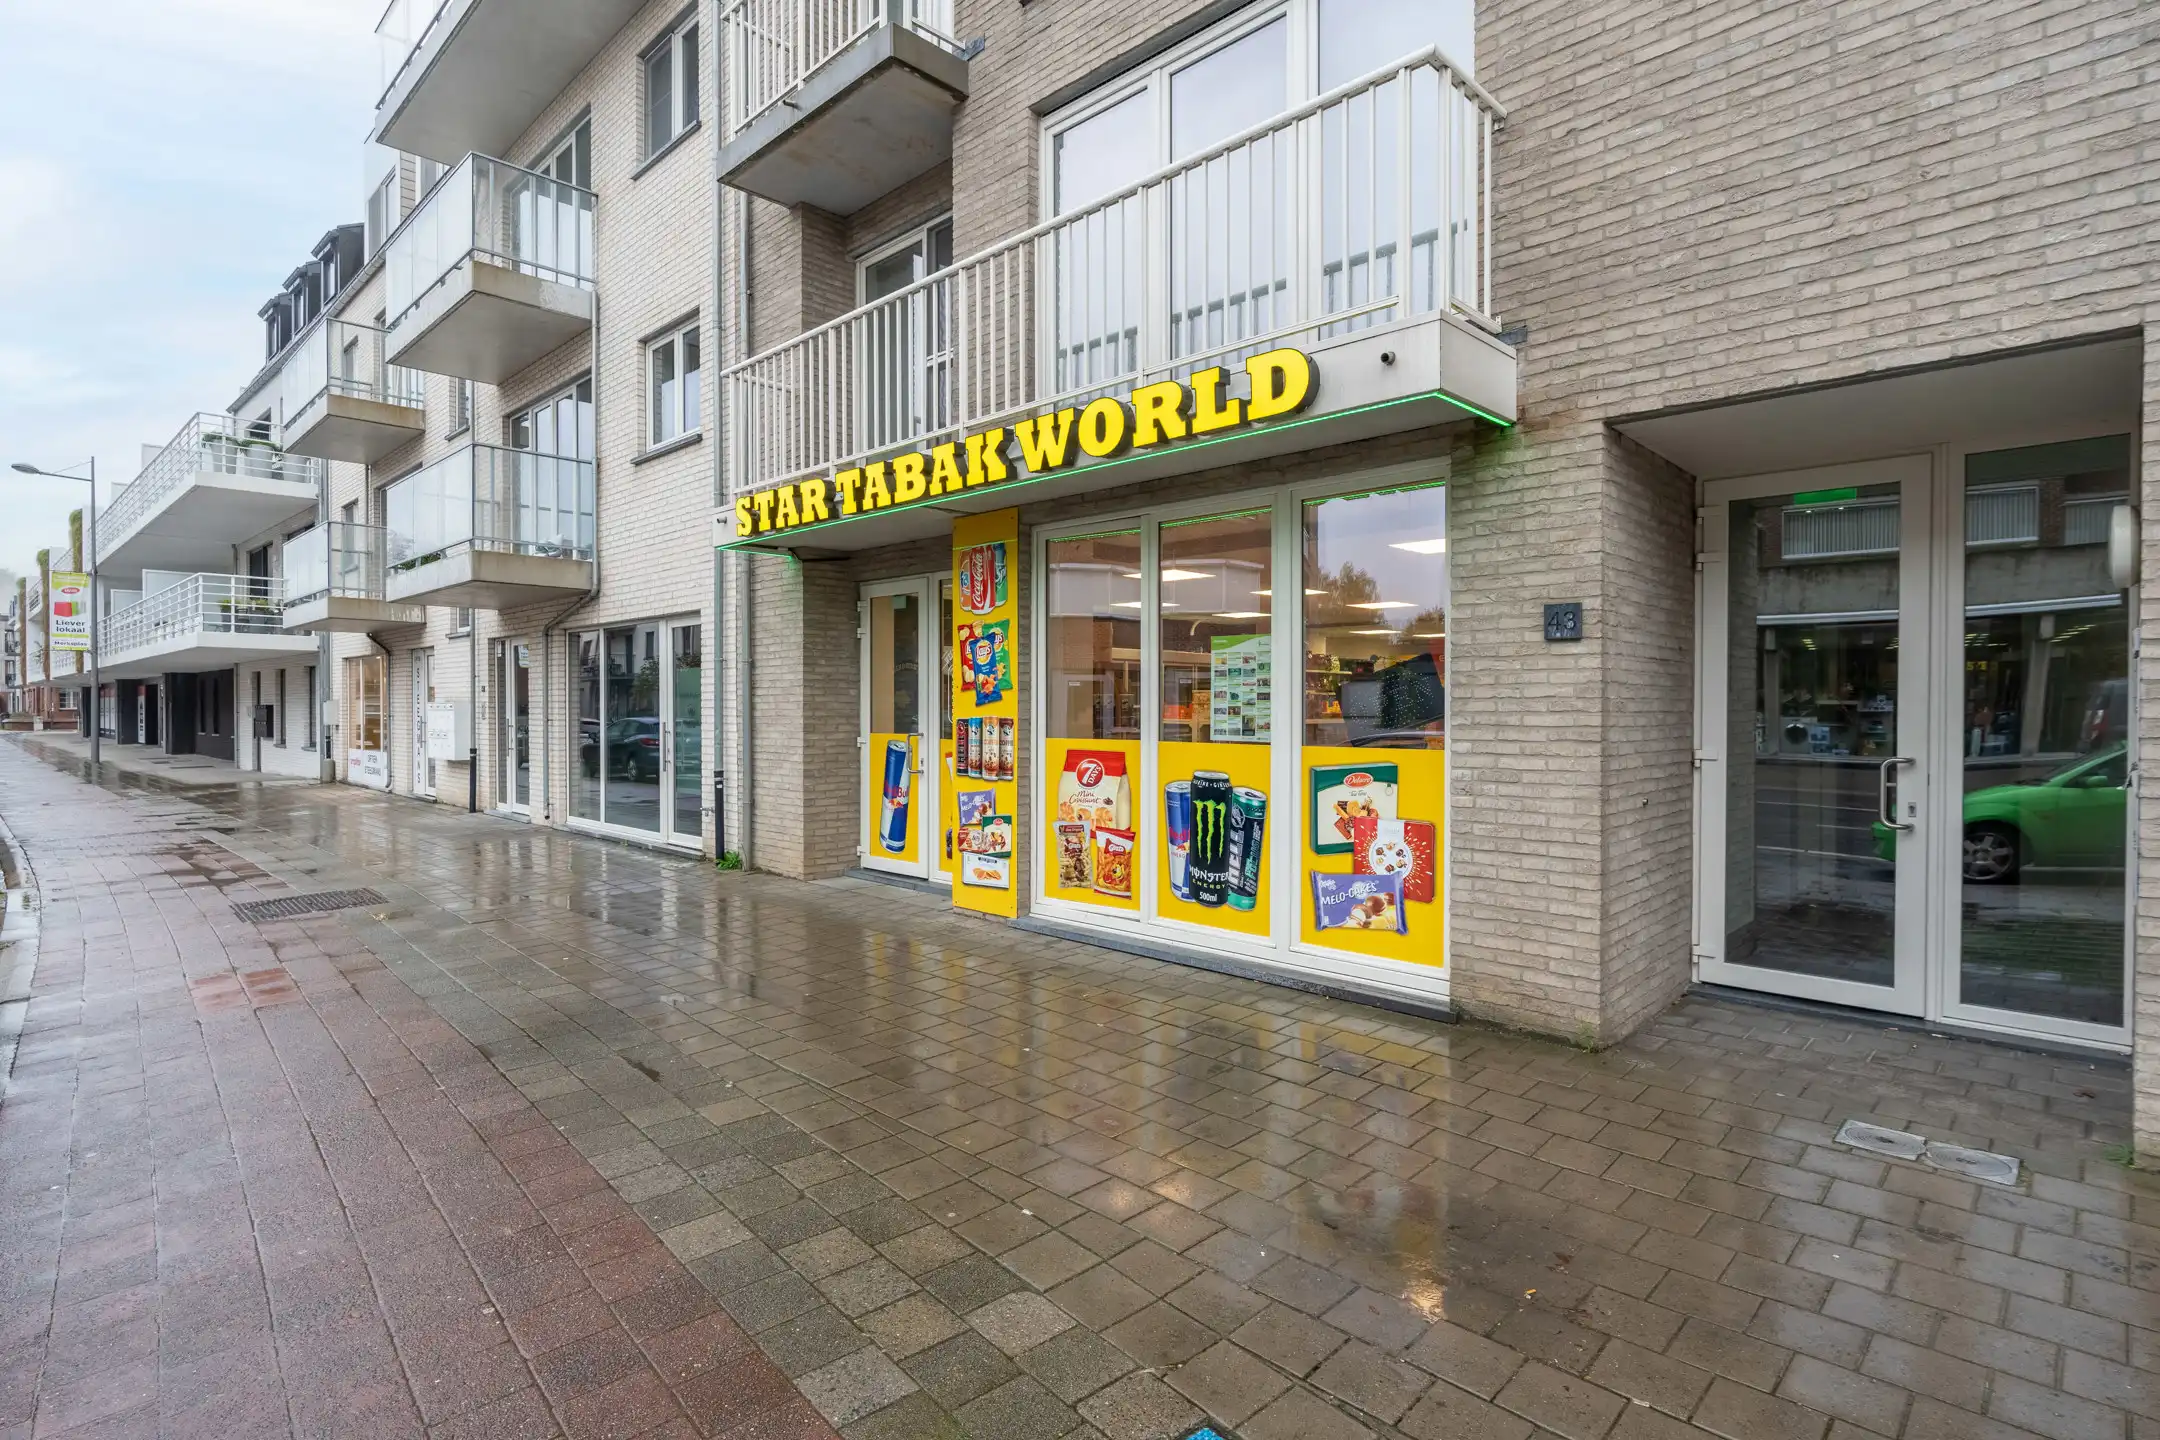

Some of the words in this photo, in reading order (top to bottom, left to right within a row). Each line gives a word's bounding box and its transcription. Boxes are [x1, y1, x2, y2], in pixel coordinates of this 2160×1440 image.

[735, 478, 830, 537] STAR
[835, 427, 1008, 515] TABAK
[1014, 348, 1312, 473] WORLD
[1547, 611, 1577, 630] 43
[1081, 762, 1097, 784] 7
[1088, 765, 1101, 784] DAYS
[1192, 879, 1226, 889] ENERGY
[1199, 891, 1218, 902] 500ml
[1321, 882, 1378, 906] MELO-CAKES
